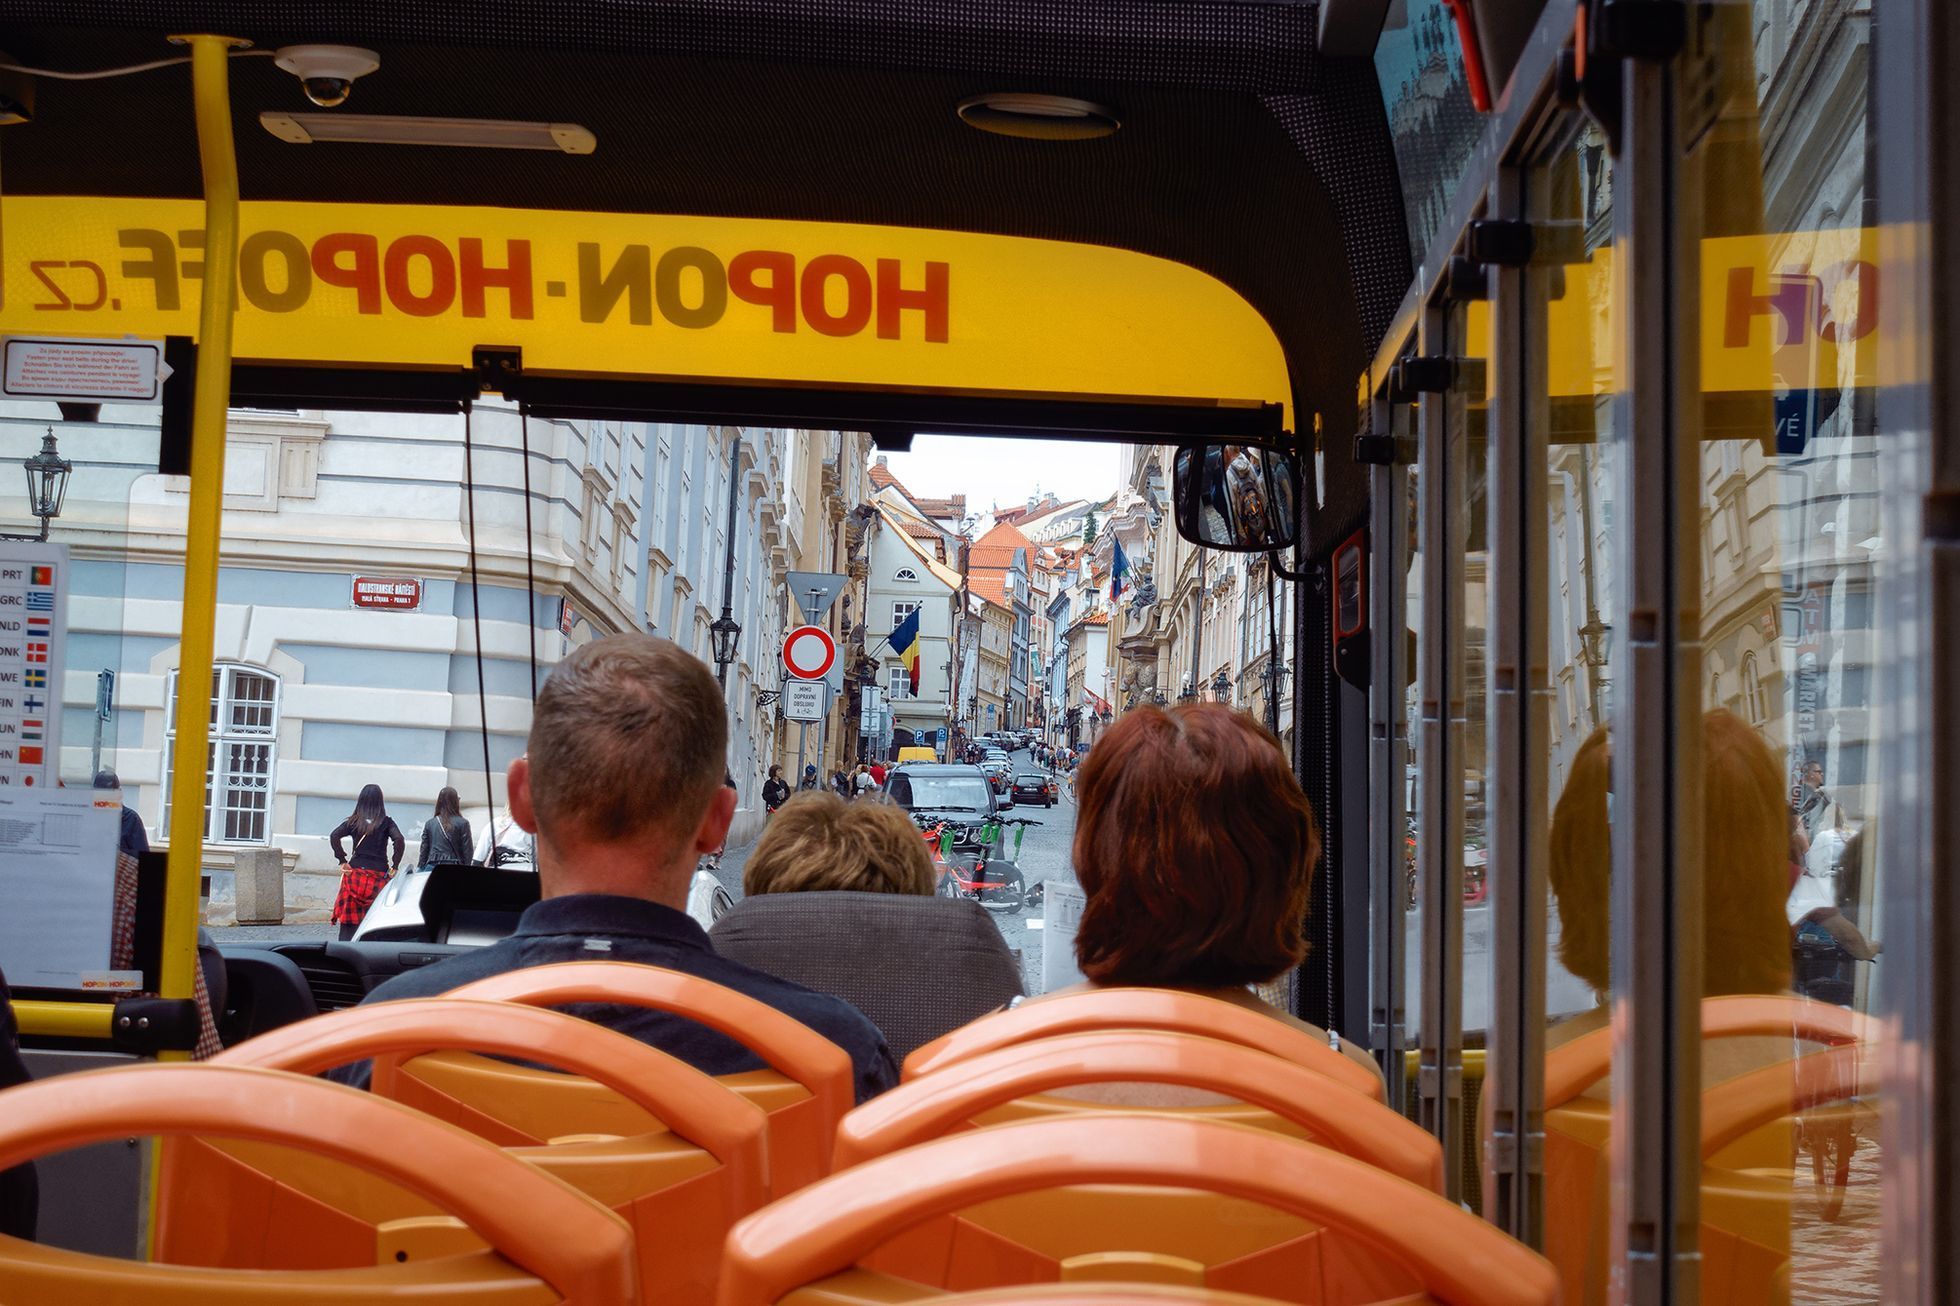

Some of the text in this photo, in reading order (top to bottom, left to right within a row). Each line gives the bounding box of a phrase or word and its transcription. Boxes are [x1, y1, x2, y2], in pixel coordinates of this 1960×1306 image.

[3, 569, 23, 580] PRT
[0, 595, 23, 606] GRC
[0, 621, 21, 631] NLD
[0, 673, 18, 683] WE
[0, 724, 16, 734] UN
[916, 731, 923, 740] P
